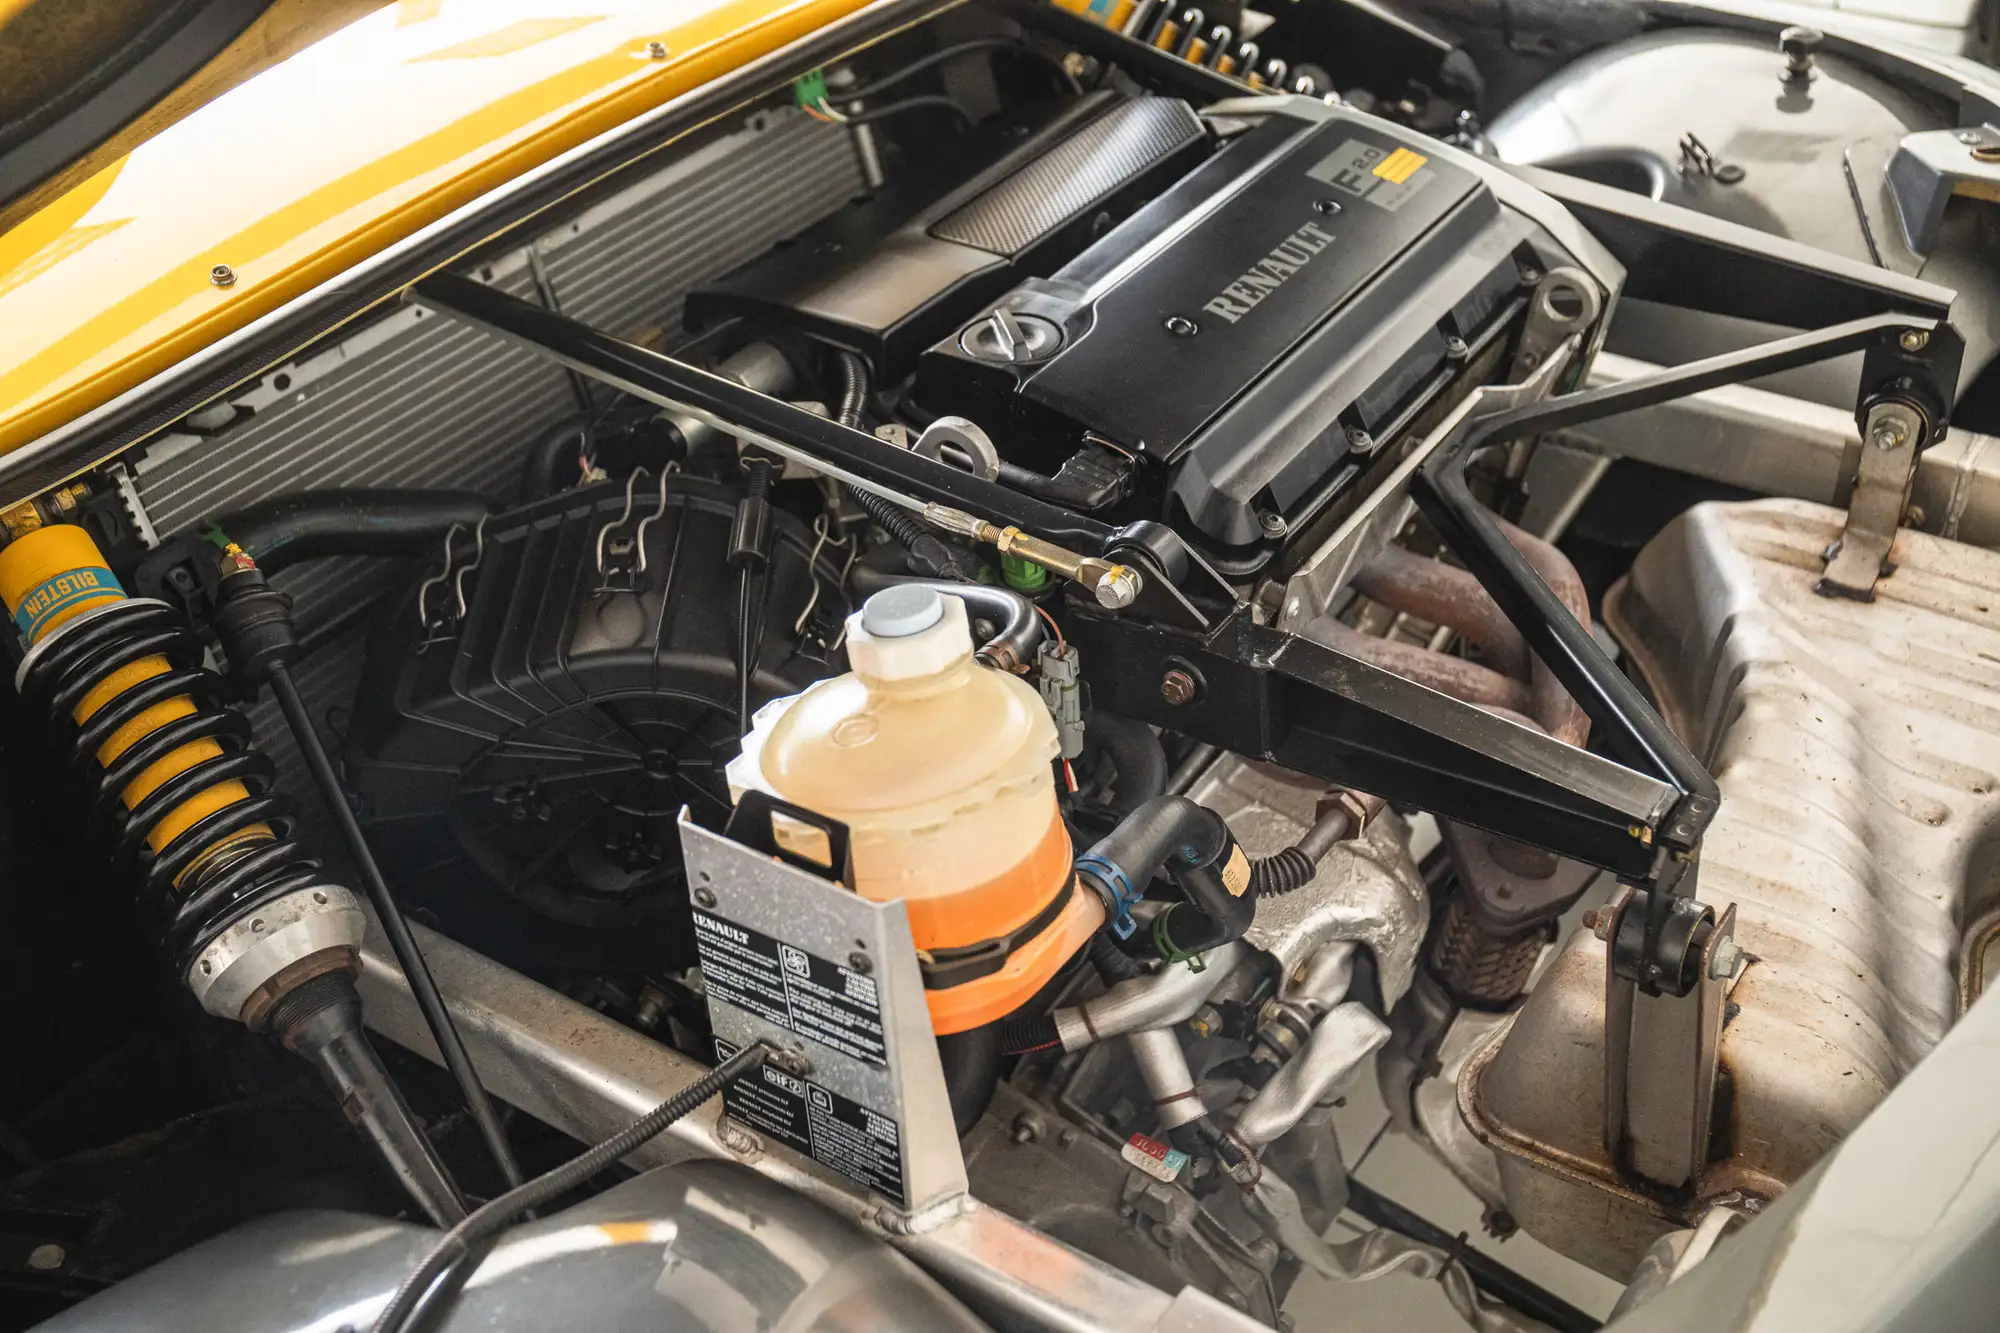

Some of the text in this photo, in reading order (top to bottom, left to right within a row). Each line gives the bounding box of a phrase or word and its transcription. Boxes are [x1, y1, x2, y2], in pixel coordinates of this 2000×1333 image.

[1330, 168, 1362, 193] F
[1202, 221, 1337, 324] RENAULT
[24, 571, 99, 619] BILSTEIN
